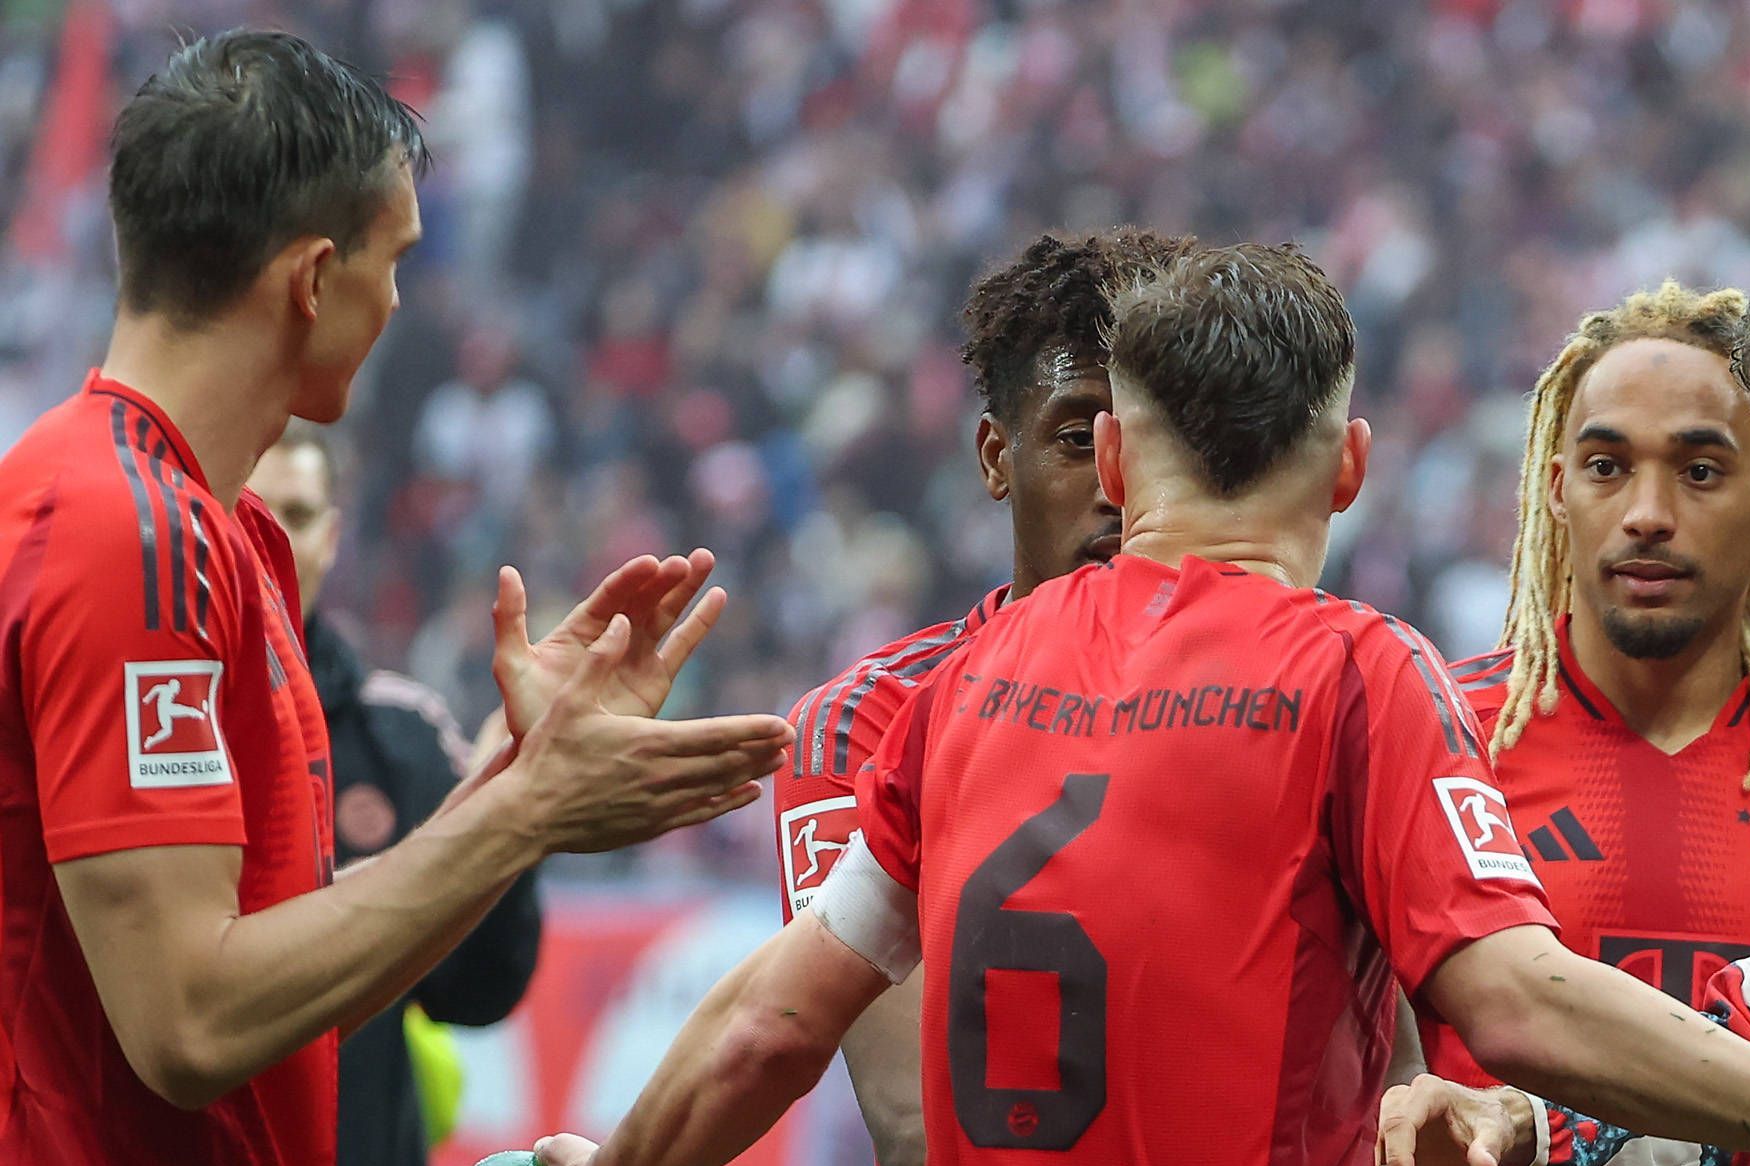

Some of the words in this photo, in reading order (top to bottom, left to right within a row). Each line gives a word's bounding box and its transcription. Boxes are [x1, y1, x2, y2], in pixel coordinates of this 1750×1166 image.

[1109, 685, 1303, 736] MÜNCHEN
[139, 761, 222, 776] BUNDESLIGA
[947, 772, 1110, 1152] 6
